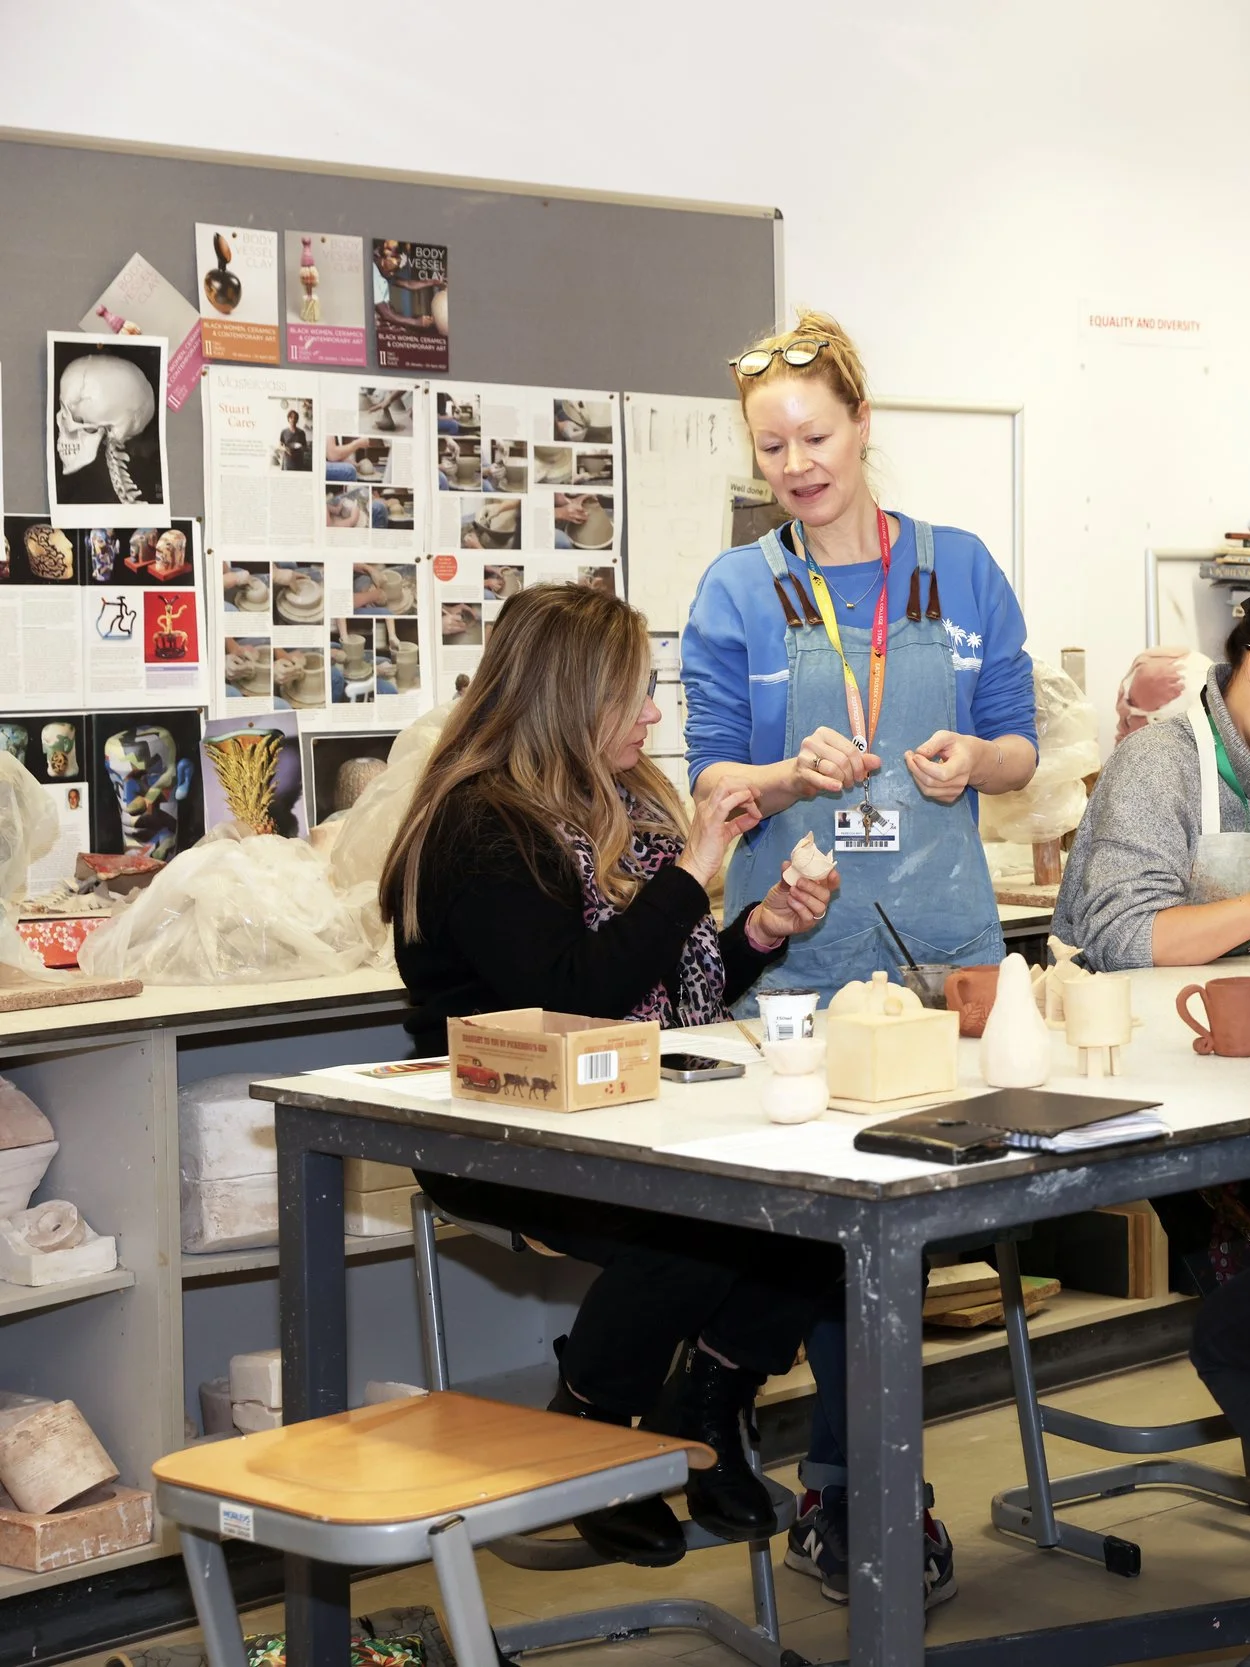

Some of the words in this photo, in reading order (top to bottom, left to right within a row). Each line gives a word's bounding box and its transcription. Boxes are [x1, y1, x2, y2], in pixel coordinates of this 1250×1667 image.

[415, 246, 445, 259] BODY
[408, 258, 445, 271] VESSEL
[418, 269, 445, 282] CLAY
[203, 321, 222, 329] BLACK
[1089, 315, 1134, 328] EQUALITY
[1136, 317, 1155, 329] AND
[1157, 318, 1201, 332] DIVERSITY
[391, 341, 435, 350] CONTEMPORARY
[217, 375, 287, 392] Masterclass
[218, 401, 250, 415] Stuart
[228, 416, 257, 430] Carey
[730, 483, 746, 493] Well
[746, 486, 764, 495] done
